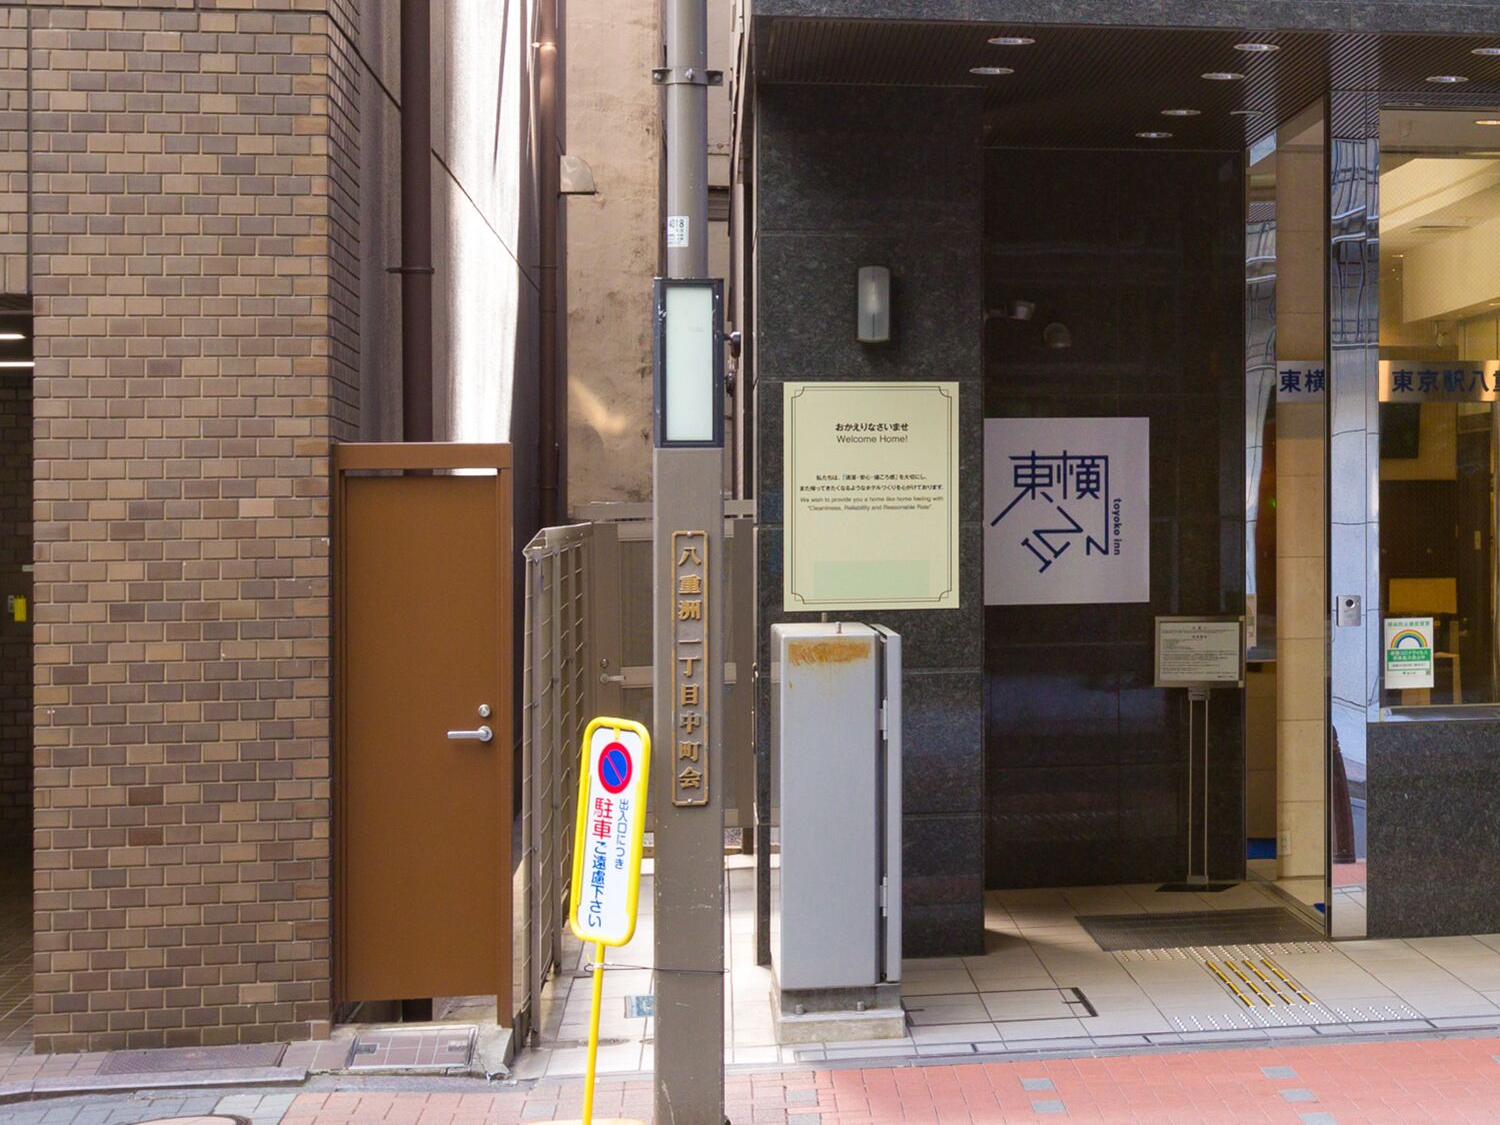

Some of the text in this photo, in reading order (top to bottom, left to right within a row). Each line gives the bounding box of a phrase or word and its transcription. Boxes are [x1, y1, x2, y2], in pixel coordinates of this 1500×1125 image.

[835, 422, 909, 432] おかえりなさいませ
[836, 435, 909, 443] Welcome Home!
[1113, 498, 1122, 556] toyoko inn
[678, 545, 702, 789] 八重洲一丁目中町会
[588, 797, 614, 928] 駐車ご遠慮下さい
[614, 798, 629, 870] 出入口につき
